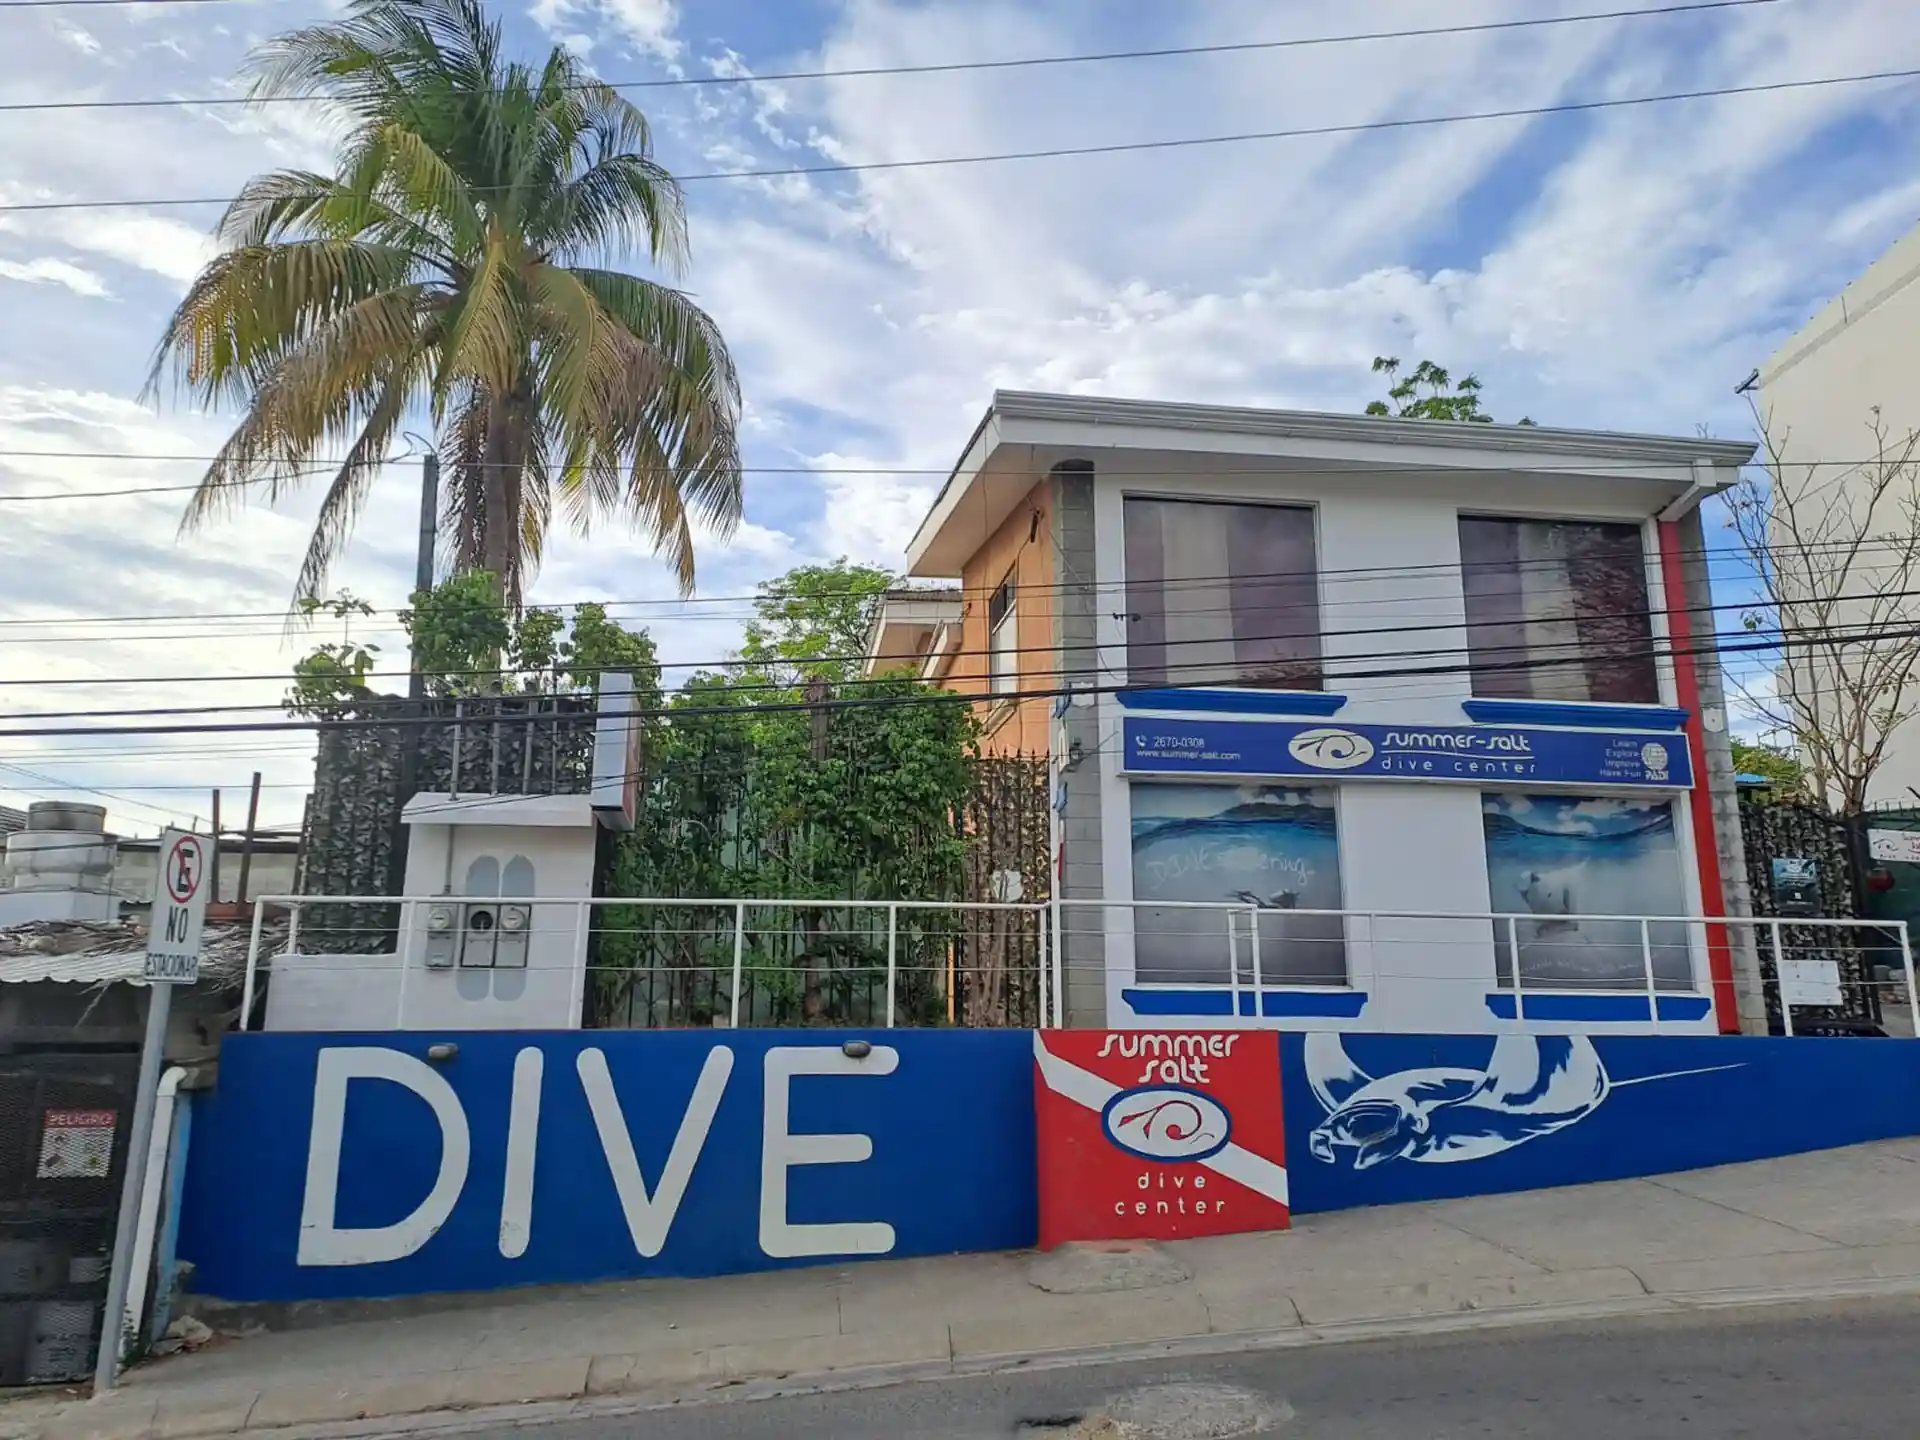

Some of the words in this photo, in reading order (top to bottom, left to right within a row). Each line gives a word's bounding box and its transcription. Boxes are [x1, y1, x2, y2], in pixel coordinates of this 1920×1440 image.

[1136, 750, 1240, 760] www.summer-salt.com
[1381, 756, 1433, 770] dive
[1453, 761, 1535, 774] center
[165, 905, 189, 943] NO
[144, 953, 198, 977] ESTACIONAR
[1138, 1056, 1210, 1084] salt
[48, 1112, 114, 1126] PELIGRO
[297, 1045, 899, 1266] DIVE
[1137, 1172, 1206, 1189] dive
[1115, 1198, 1225, 1215] center
